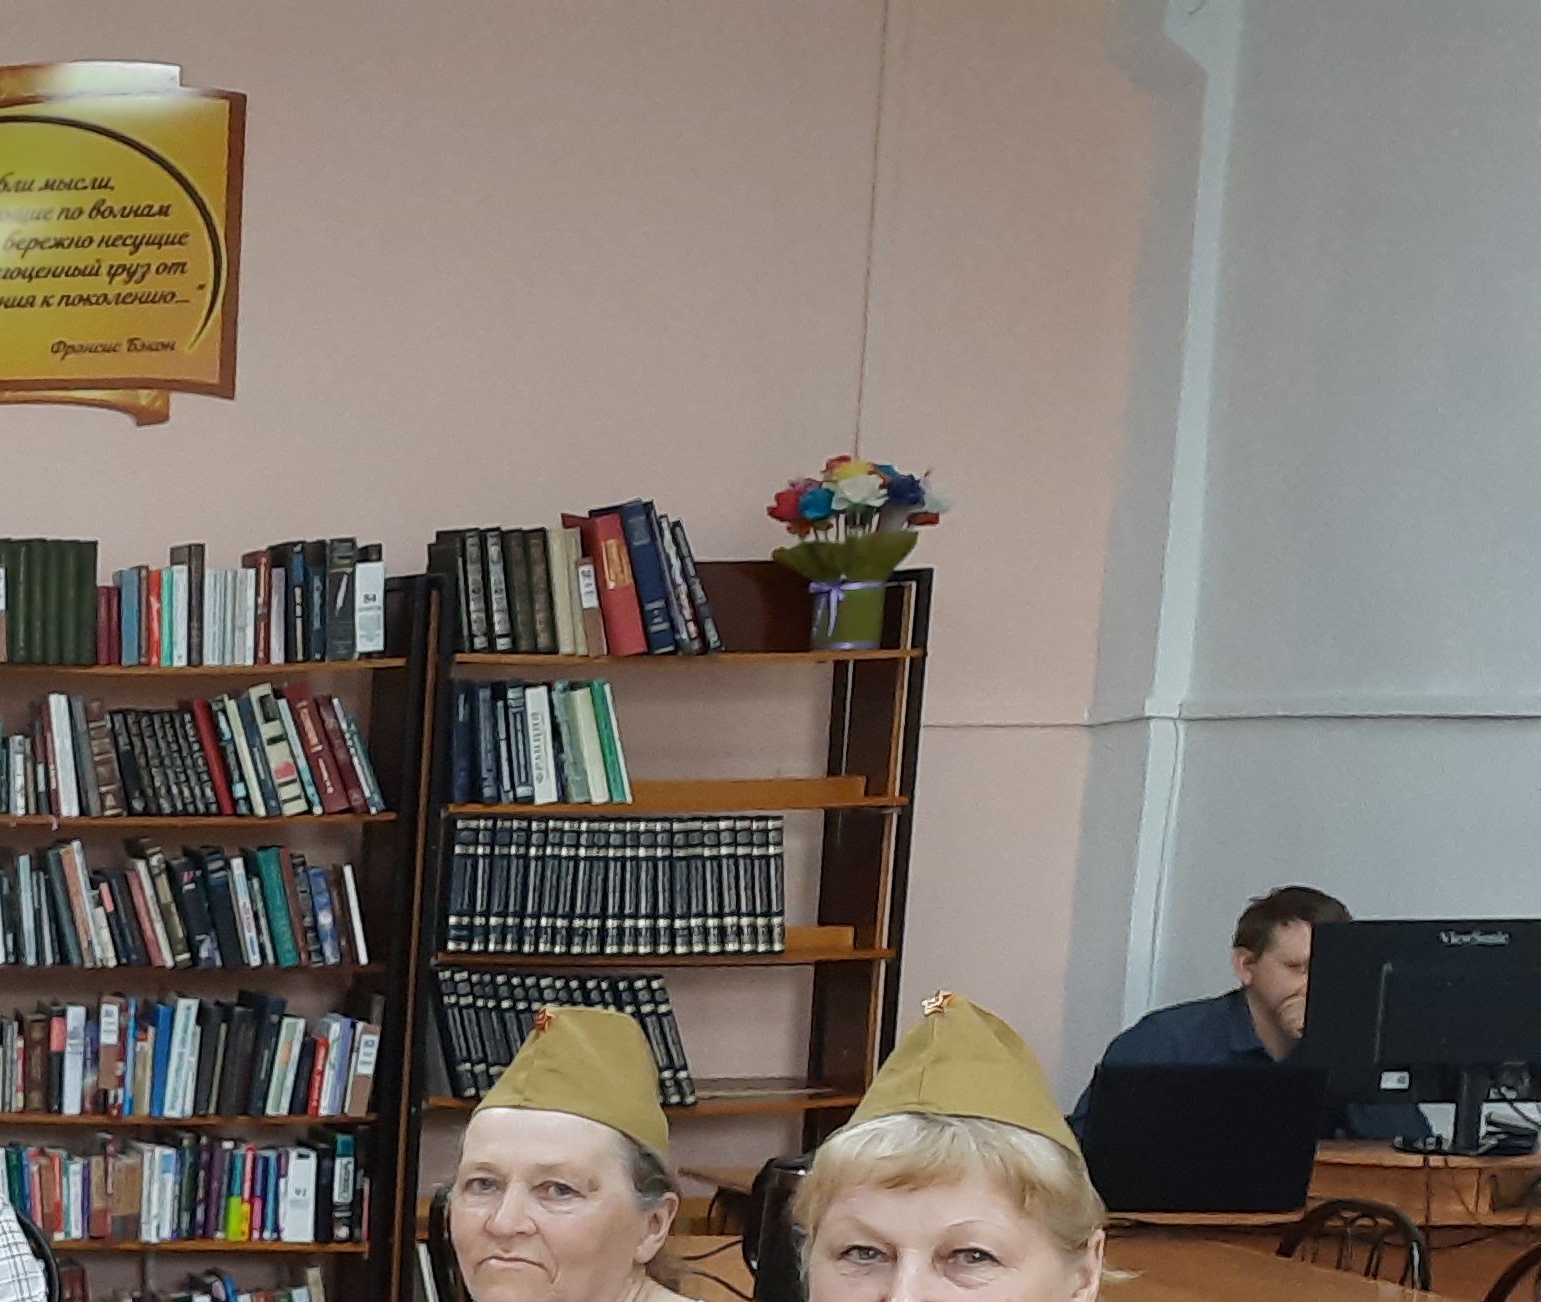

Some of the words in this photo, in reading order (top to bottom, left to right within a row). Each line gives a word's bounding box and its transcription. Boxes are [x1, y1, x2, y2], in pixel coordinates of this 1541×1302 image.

[38, 174, 115, 193] мысли,
[56, 207, 84, 225] по
[88, 198, 172, 219] волнам
[3, 227, 94, 258] бережно
[97, 231, 191, 256] несущие
[106, 262, 152, 286] груз
[155, 261, 189, 276] от
[39, 294, 52, 308] к
